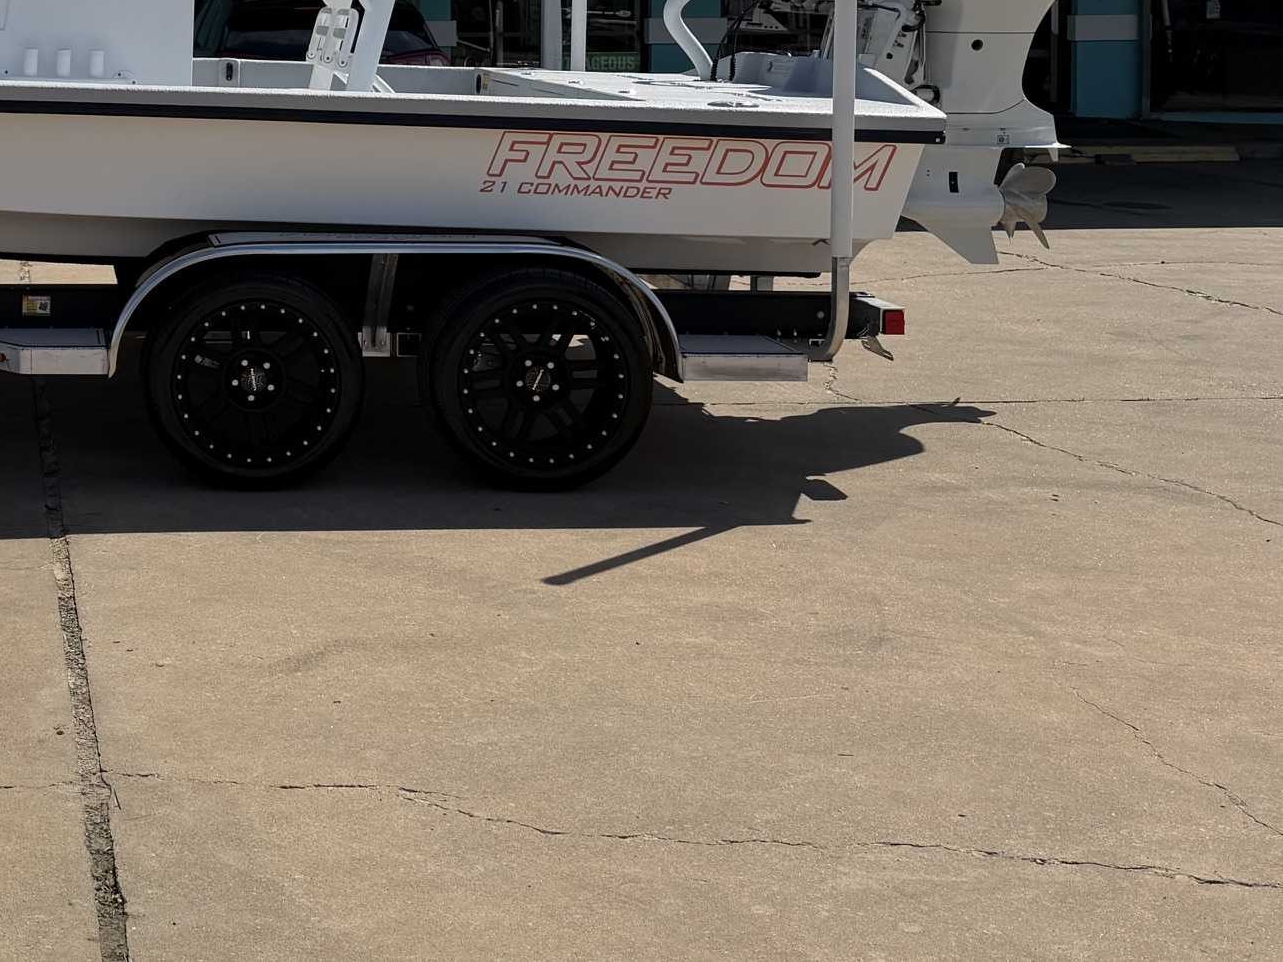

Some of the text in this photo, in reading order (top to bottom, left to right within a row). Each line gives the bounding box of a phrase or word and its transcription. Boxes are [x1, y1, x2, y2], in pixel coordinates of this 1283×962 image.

[486, 130, 897, 191] FREEDOM
[479, 180, 673, 200] 21 COMMANDER
